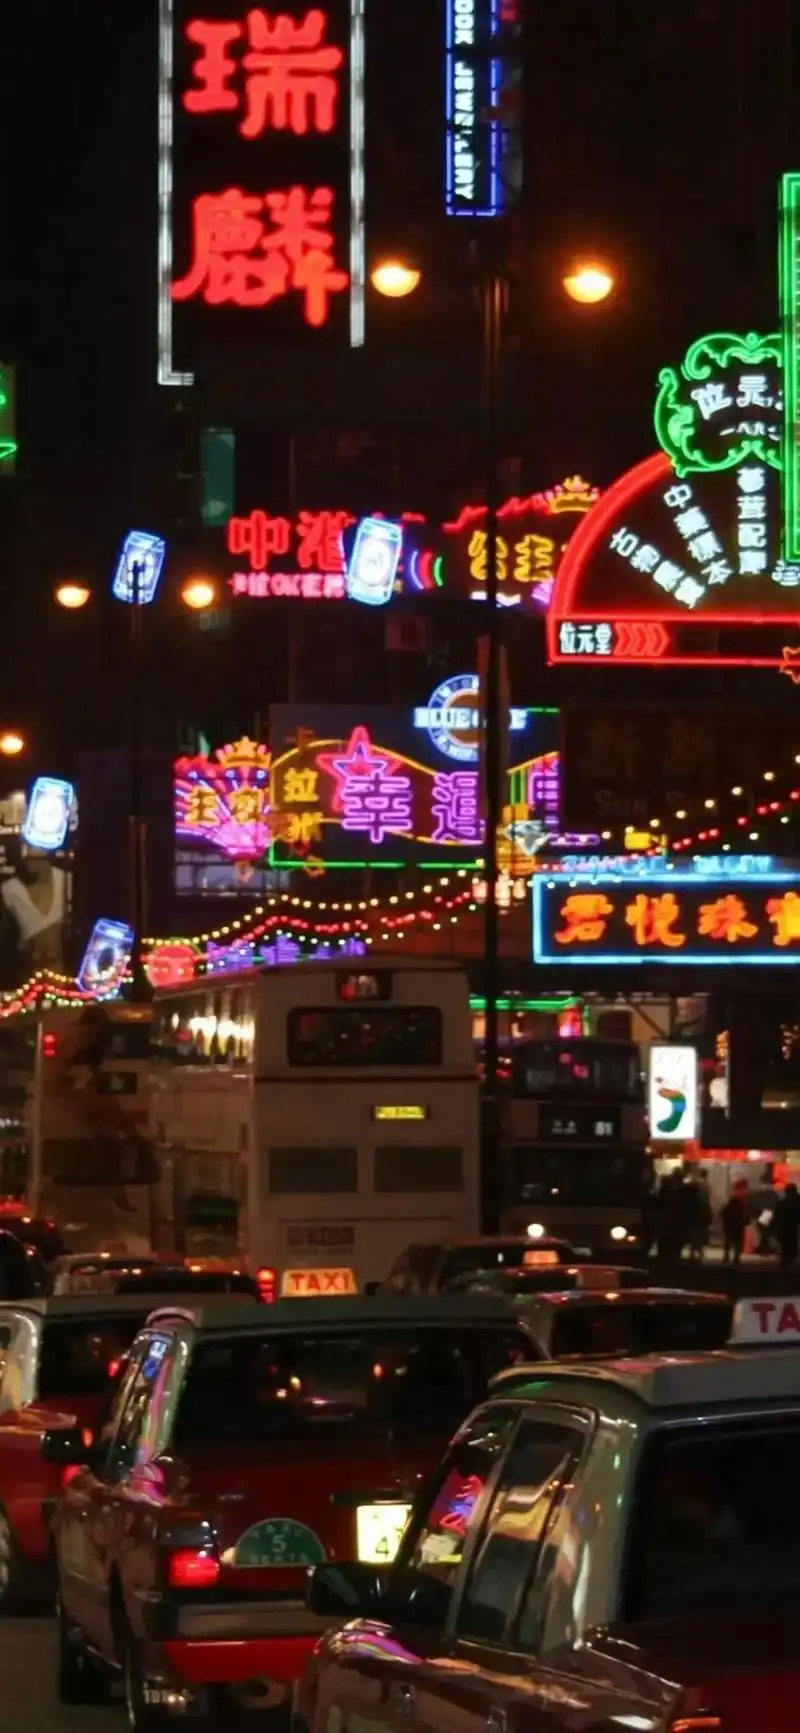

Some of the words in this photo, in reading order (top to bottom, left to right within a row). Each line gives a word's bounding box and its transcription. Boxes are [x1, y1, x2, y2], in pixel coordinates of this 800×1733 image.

[171, 8, 348, 327] 瑞麟
[691, 374, 784, 420] 位元
[559, 623, 611, 656] 位元堂
[290, 1272, 352, 1292] TAXI
[751, 1302, 800, 1334] TA
[271, 1533, 288, 1554] 5
